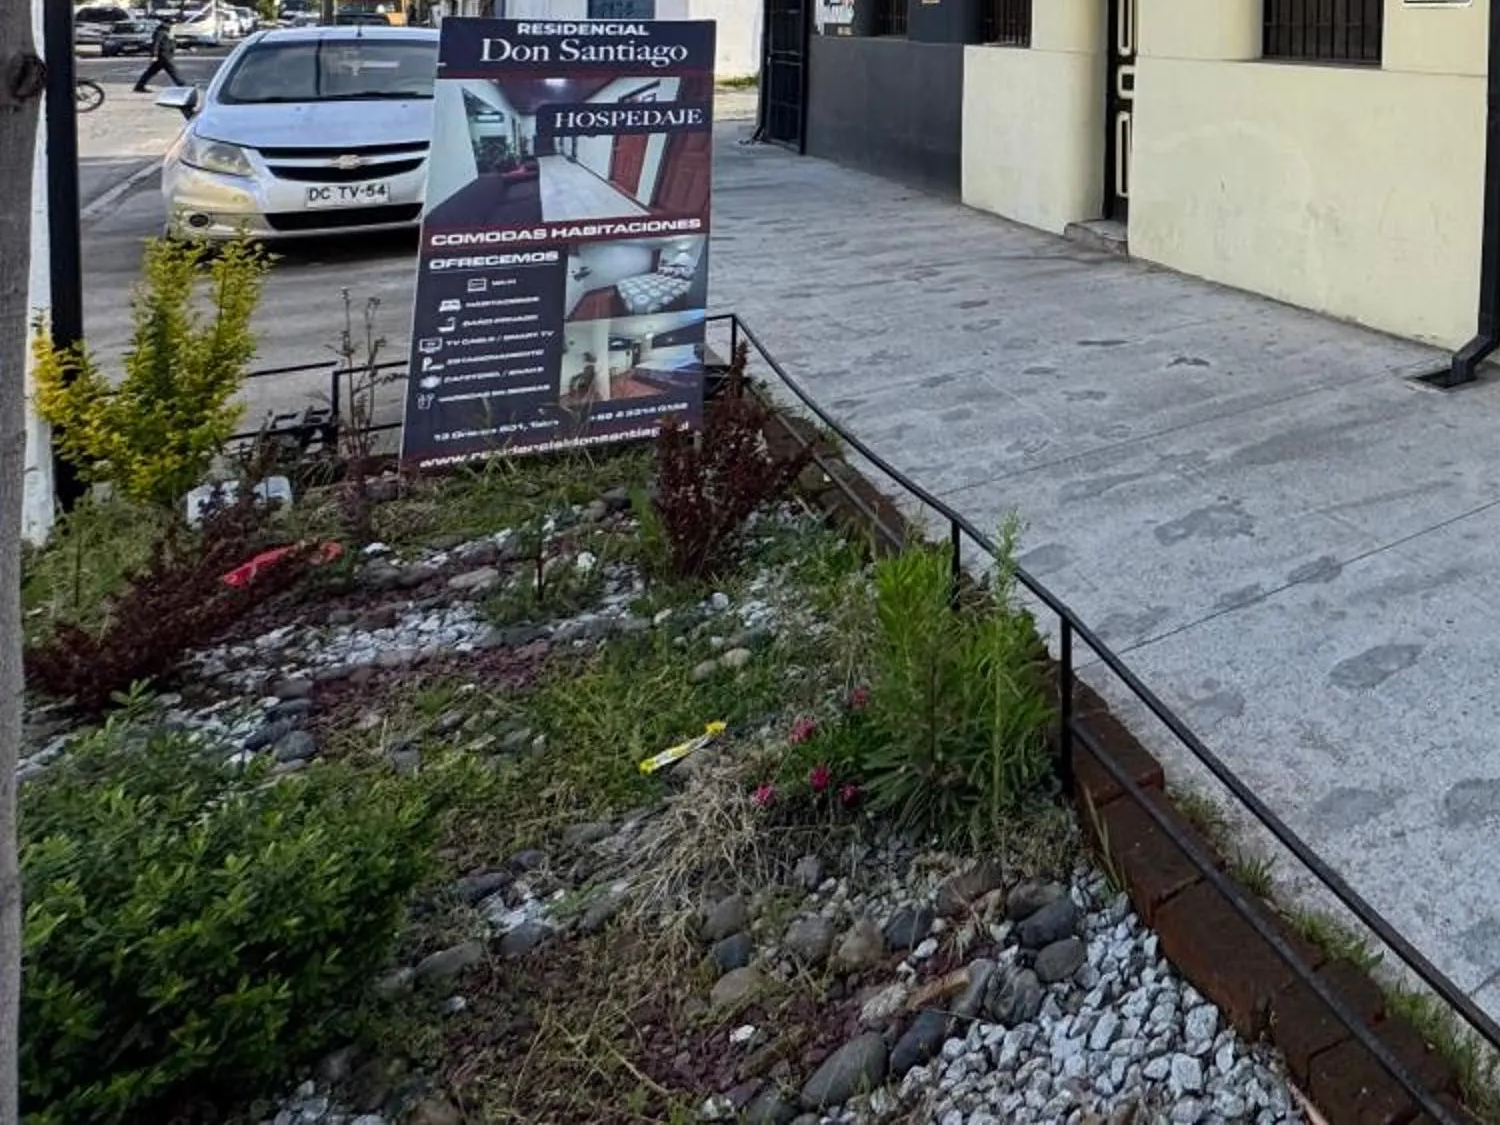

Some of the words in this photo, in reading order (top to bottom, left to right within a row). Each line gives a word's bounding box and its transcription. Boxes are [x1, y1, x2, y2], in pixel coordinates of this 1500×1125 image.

[517, 22, 650, 36] RESIDENCIAL
[480, 37, 549, 63] Don
[559, 37, 689, 68] Santiago
[554, 107, 704, 129] HOSPEDAJE
[308, 186, 331, 202] DC
[431, 228, 548, 247] COMODAS
[551, 217, 702, 239] HABITACIONES
[429, 250, 560, 271] OFRECEMOS
